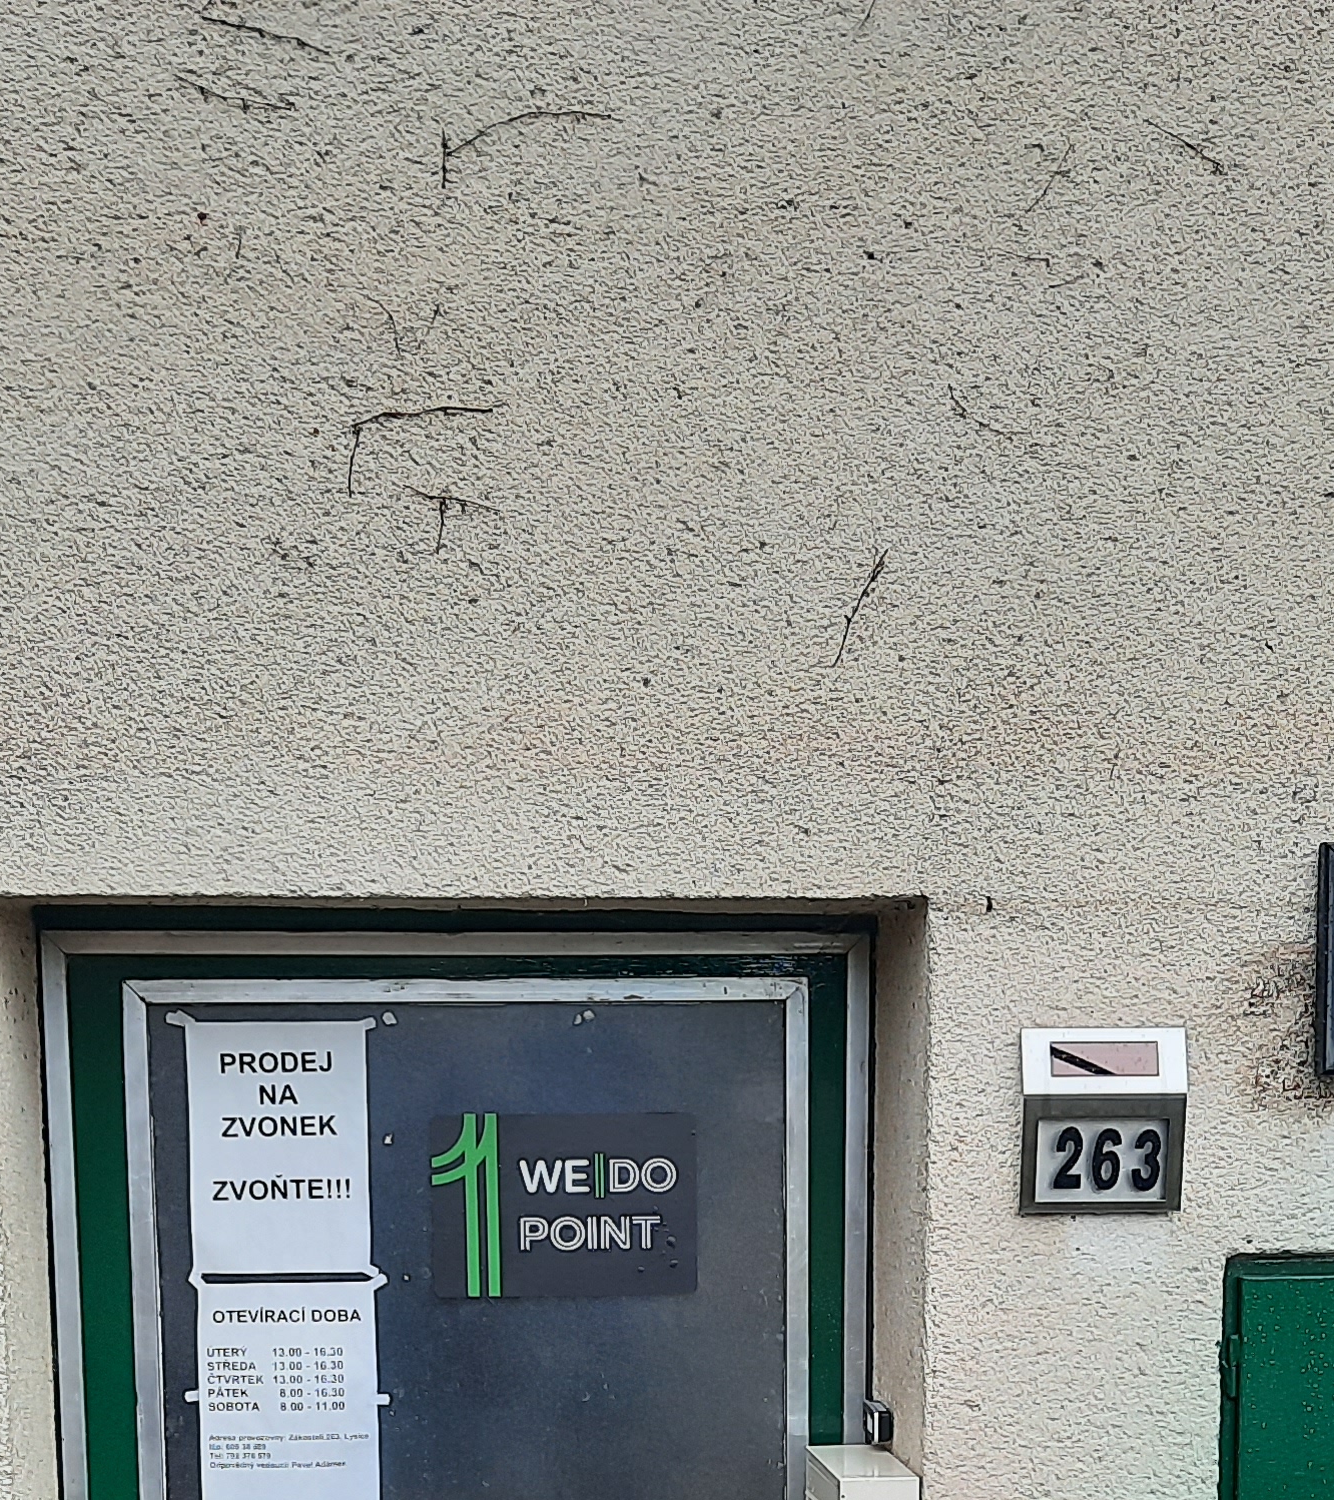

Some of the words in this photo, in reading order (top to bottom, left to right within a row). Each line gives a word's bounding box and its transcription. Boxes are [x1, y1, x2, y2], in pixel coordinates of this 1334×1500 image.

[219, 1050, 333, 1075] PRODEJ
[258, 1083, 299, 1106] NA
[221, 1114, 338, 1138] ZVONEK
[1052, 1125, 1162, 1192] 263
[212, 1174, 352, 1202] ZVOŇTE!!!
[519, 1215, 662, 1251] POINT
[212, 1306, 307, 1324] OTEVÍRACÍ
[311, 1308, 363, 1323] DOBA
[208, 1401, 261, 1412] SOBOTA
